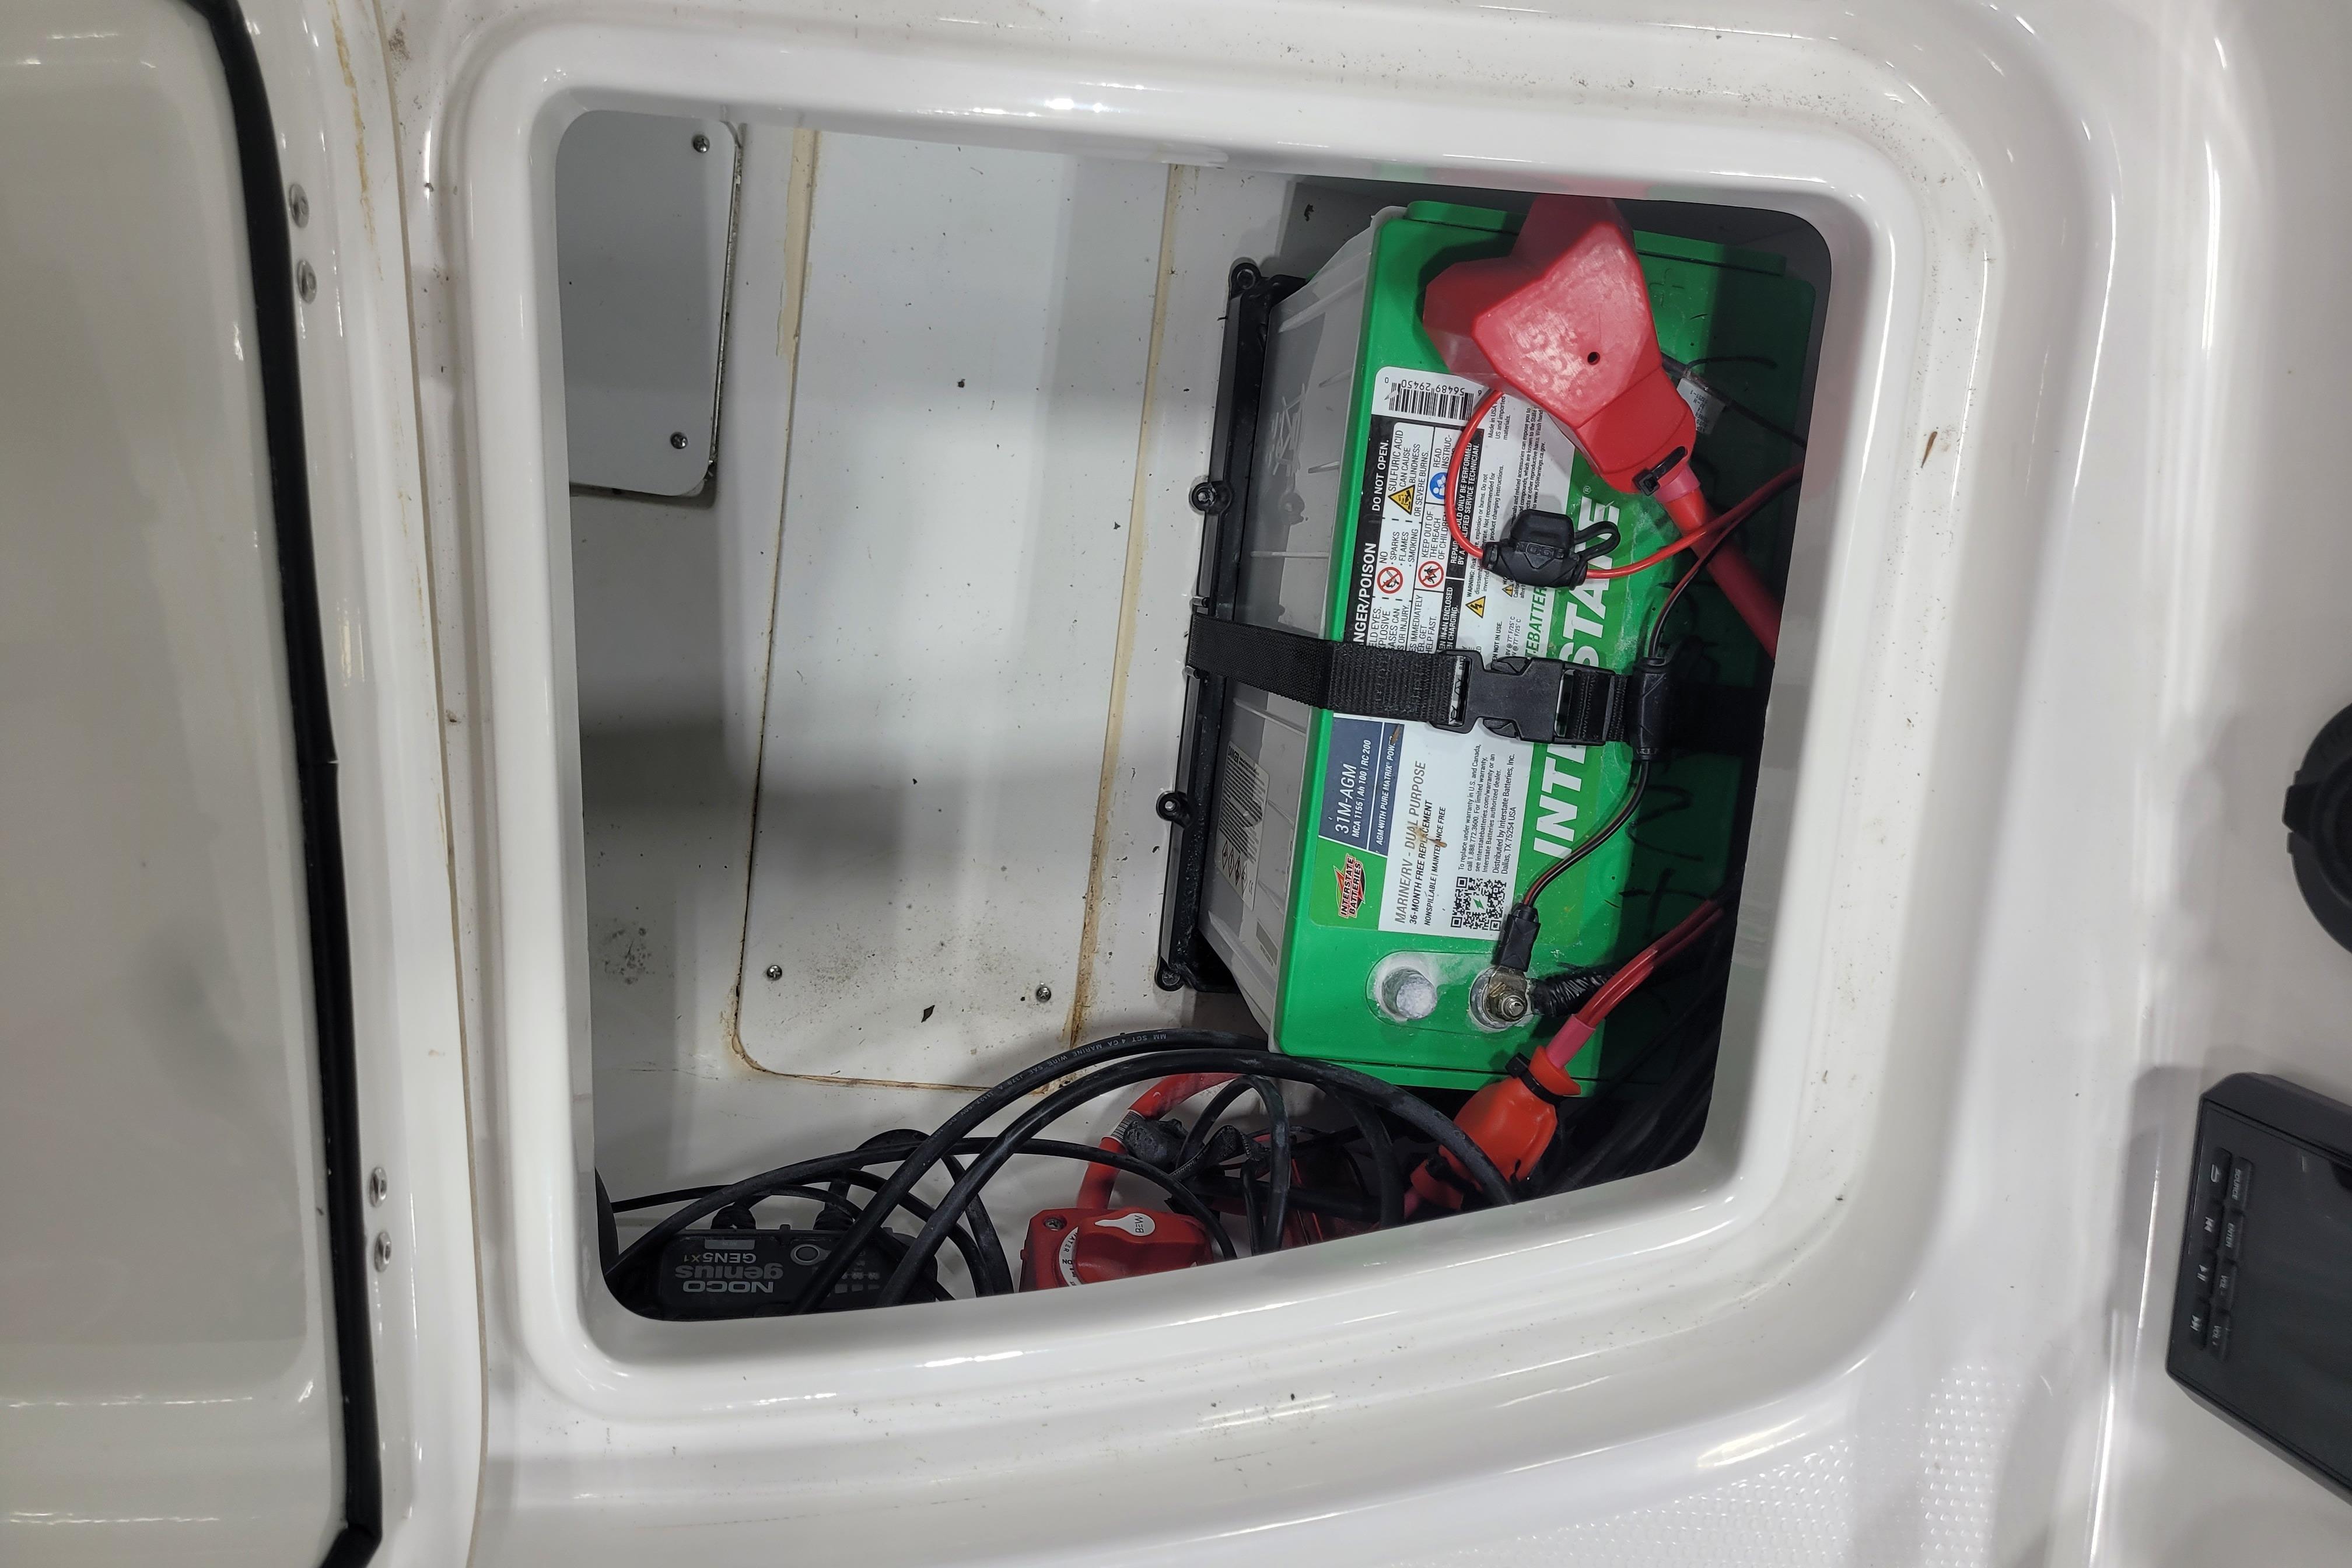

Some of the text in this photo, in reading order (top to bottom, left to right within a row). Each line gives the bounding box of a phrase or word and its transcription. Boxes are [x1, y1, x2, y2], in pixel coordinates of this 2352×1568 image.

[1401, 379, 1431, 391] 29450
[1435, 384, 1465, 396] 56489
[1497, 396, 1507, 419] imported
[1503, 414, 1511, 440] materials.
[1388, 429, 1404, 492] SULFURIC ACID
[1409, 443, 1420, 483] BLINDNESS
[1433, 447, 1442, 467] READ
[1441, 434, 1452, 468] INSTRUC-
[1517, 450, 1525, 478] accessories
[1371, 439, 1389, 511] DO NOT OPEN.
[1399, 447, 1410, 487] CAN CAUSE
[1457, 442, 1472, 512] ONLY BE PERFORMED
[1494, 464, 1504, 496] instructions.
[1413, 450, 1429, 516] OR SEVERE BURNS.
[1457, 442, 1479, 565] BY SERVICE TECHNICIAN.
[1484, 480, 1494, 517] recommended
[1492, 497, 1500, 520] charging
[1390, 531, 1399, 560] SPARKS
[1399, 531, 1409, 561] FLAMES
[1408, 528, 1419, 562] SMOKING
[1422, 510, 1433, 558] KEEP OUT OF
[1430, 517, 1441, 558] THE REACH
[1489, 521, 1497, 541] product
[1379, 551, 1388, 564] NO
[1436, 548, 1446, 560] OF
[1466, 570, 1475, 597] WARNING:
[1474, 514, 1484, 540] explosion
[1351, 542, 1378, 645] NGER/POISON
[1443, 587, 1452, 620] ENCLOSED
[1368, 606, 1381, 646] ELD EYES.
[1392, 608, 1400, 623] CAN
[1399, 604, 1409, 631] INJURY.
[1410, 594, 1423, 642] IMMEDIATELY
[1427, 615, 1437, 635] FAST.
[1447, 604, 1458, 640] CHARGING.
[1398, 633, 1406, 643] OR
[1419, 625, 1427, 639] GET
[1472, 743, 1481, 766] Canada,
[1478, 756, 1488, 782] warranty,
[1351, 739, 1371, 837] MCA 1155 Ah 100 RC 200
[1475, 783, 1483, 803] limited
[1502, 766, 1514, 797] Batteries,
[1333, 763, 1358, 834] 31M-AGM
[1379, 790, 1389, 810] PURE
[1464, 798, 1474, 824] warranty
[1498, 797, 1508, 828] Interstate
[1377, 810, 1387, 828] WITH
[1475, 769, 1494, 861] interstatebatteries.com/warranty
[1482, 769, 1501, 873] Interstate Batteries authorized dealer.
[1375, 830, 1384, 845] AGM
[1394, 760, 1426, 923] MARINE/RV DUAL PURPOSE
[1462, 824, 1470, 841] under
[1467, 814, 1479, 860] 1.888.772.3600.
[1497, 829, 1506, 838] by
[1506, 821, 1514, 841] 75254
[1409, 799, 1433, 924] 36-MONTH FREE REPLACEMENT
[1459, 841, 1469, 862] replace
[1492, 838, 1503, 873] Distributed
[1504, 844, 1511, 852] TX
[1424, 876, 1437, 926] NONSPILLABLE
[1437, 806, 1446, 824] FREE
[1502, 853, 1511, 874] Dallas,
[1339, 858, 1354, 916] INTERSTATE
[1348, 862, 1362, 915] BATTERIES
[1070, 1042, 1102, 1056] MARINE
[2229, 1167, 2243, 1200] SOURCE
[2223, 1222, 2236, 1248] ENTER
[674, 1261, 783, 1280] genius
[681, 1279, 774, 1293] NOCO
